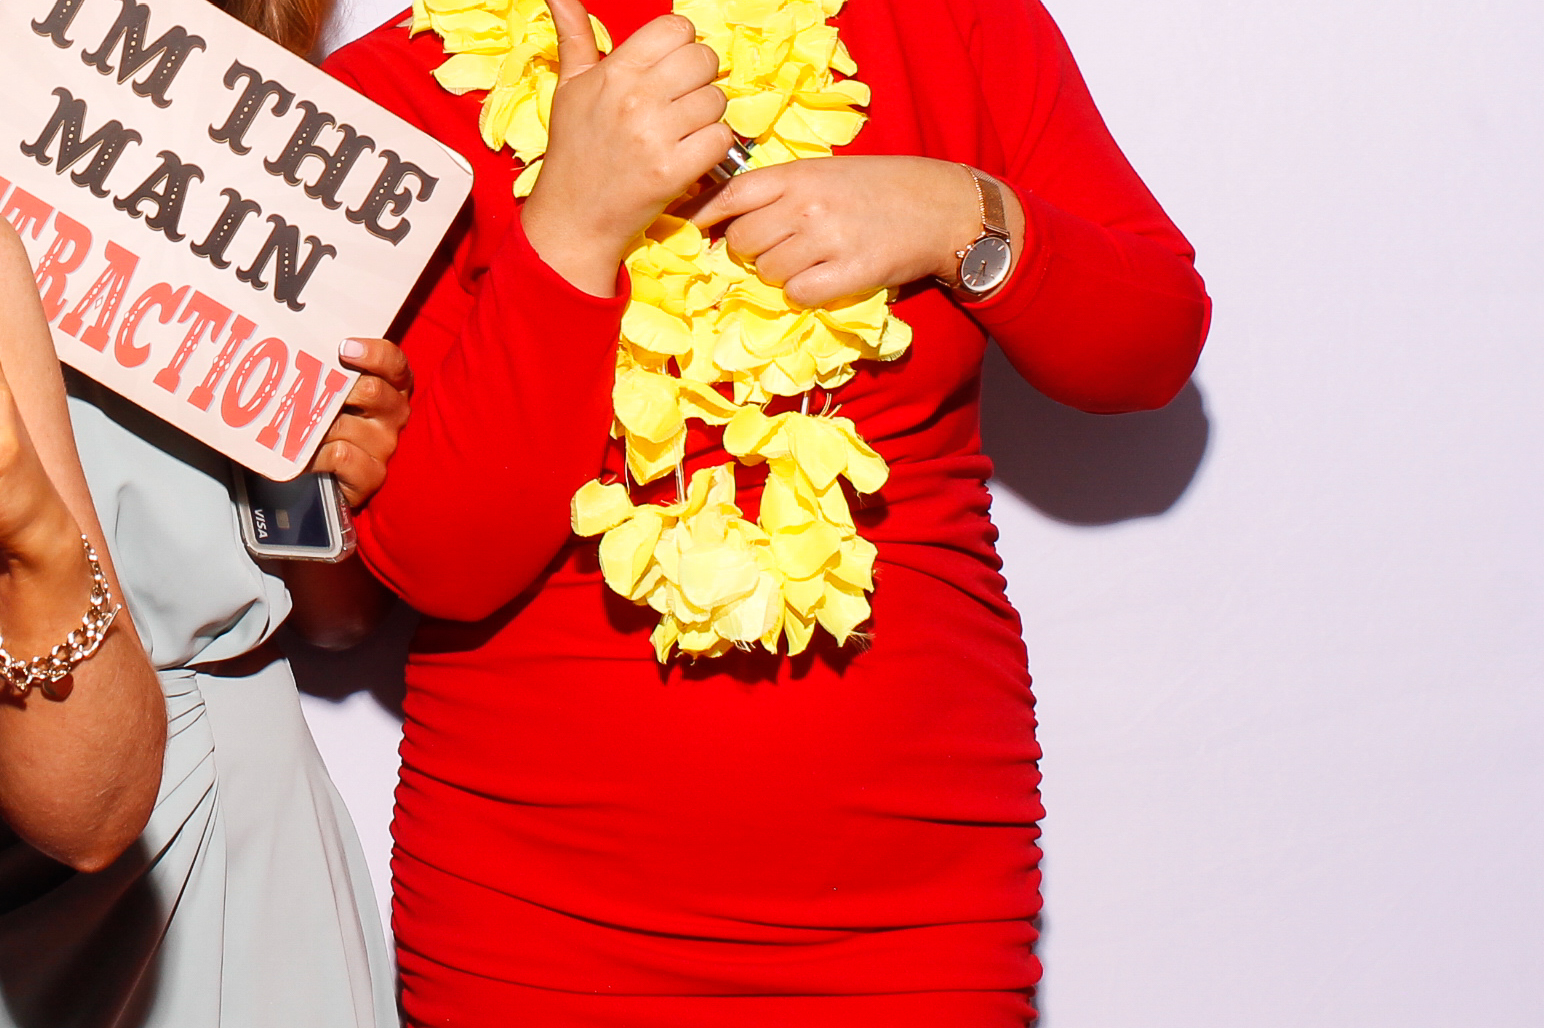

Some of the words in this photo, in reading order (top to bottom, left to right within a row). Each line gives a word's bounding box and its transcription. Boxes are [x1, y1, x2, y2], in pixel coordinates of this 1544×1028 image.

[19, 87, 337, 312] MAIN
[207, 58, 439, 247] THE
[254, 508, 269, 539] VISA
